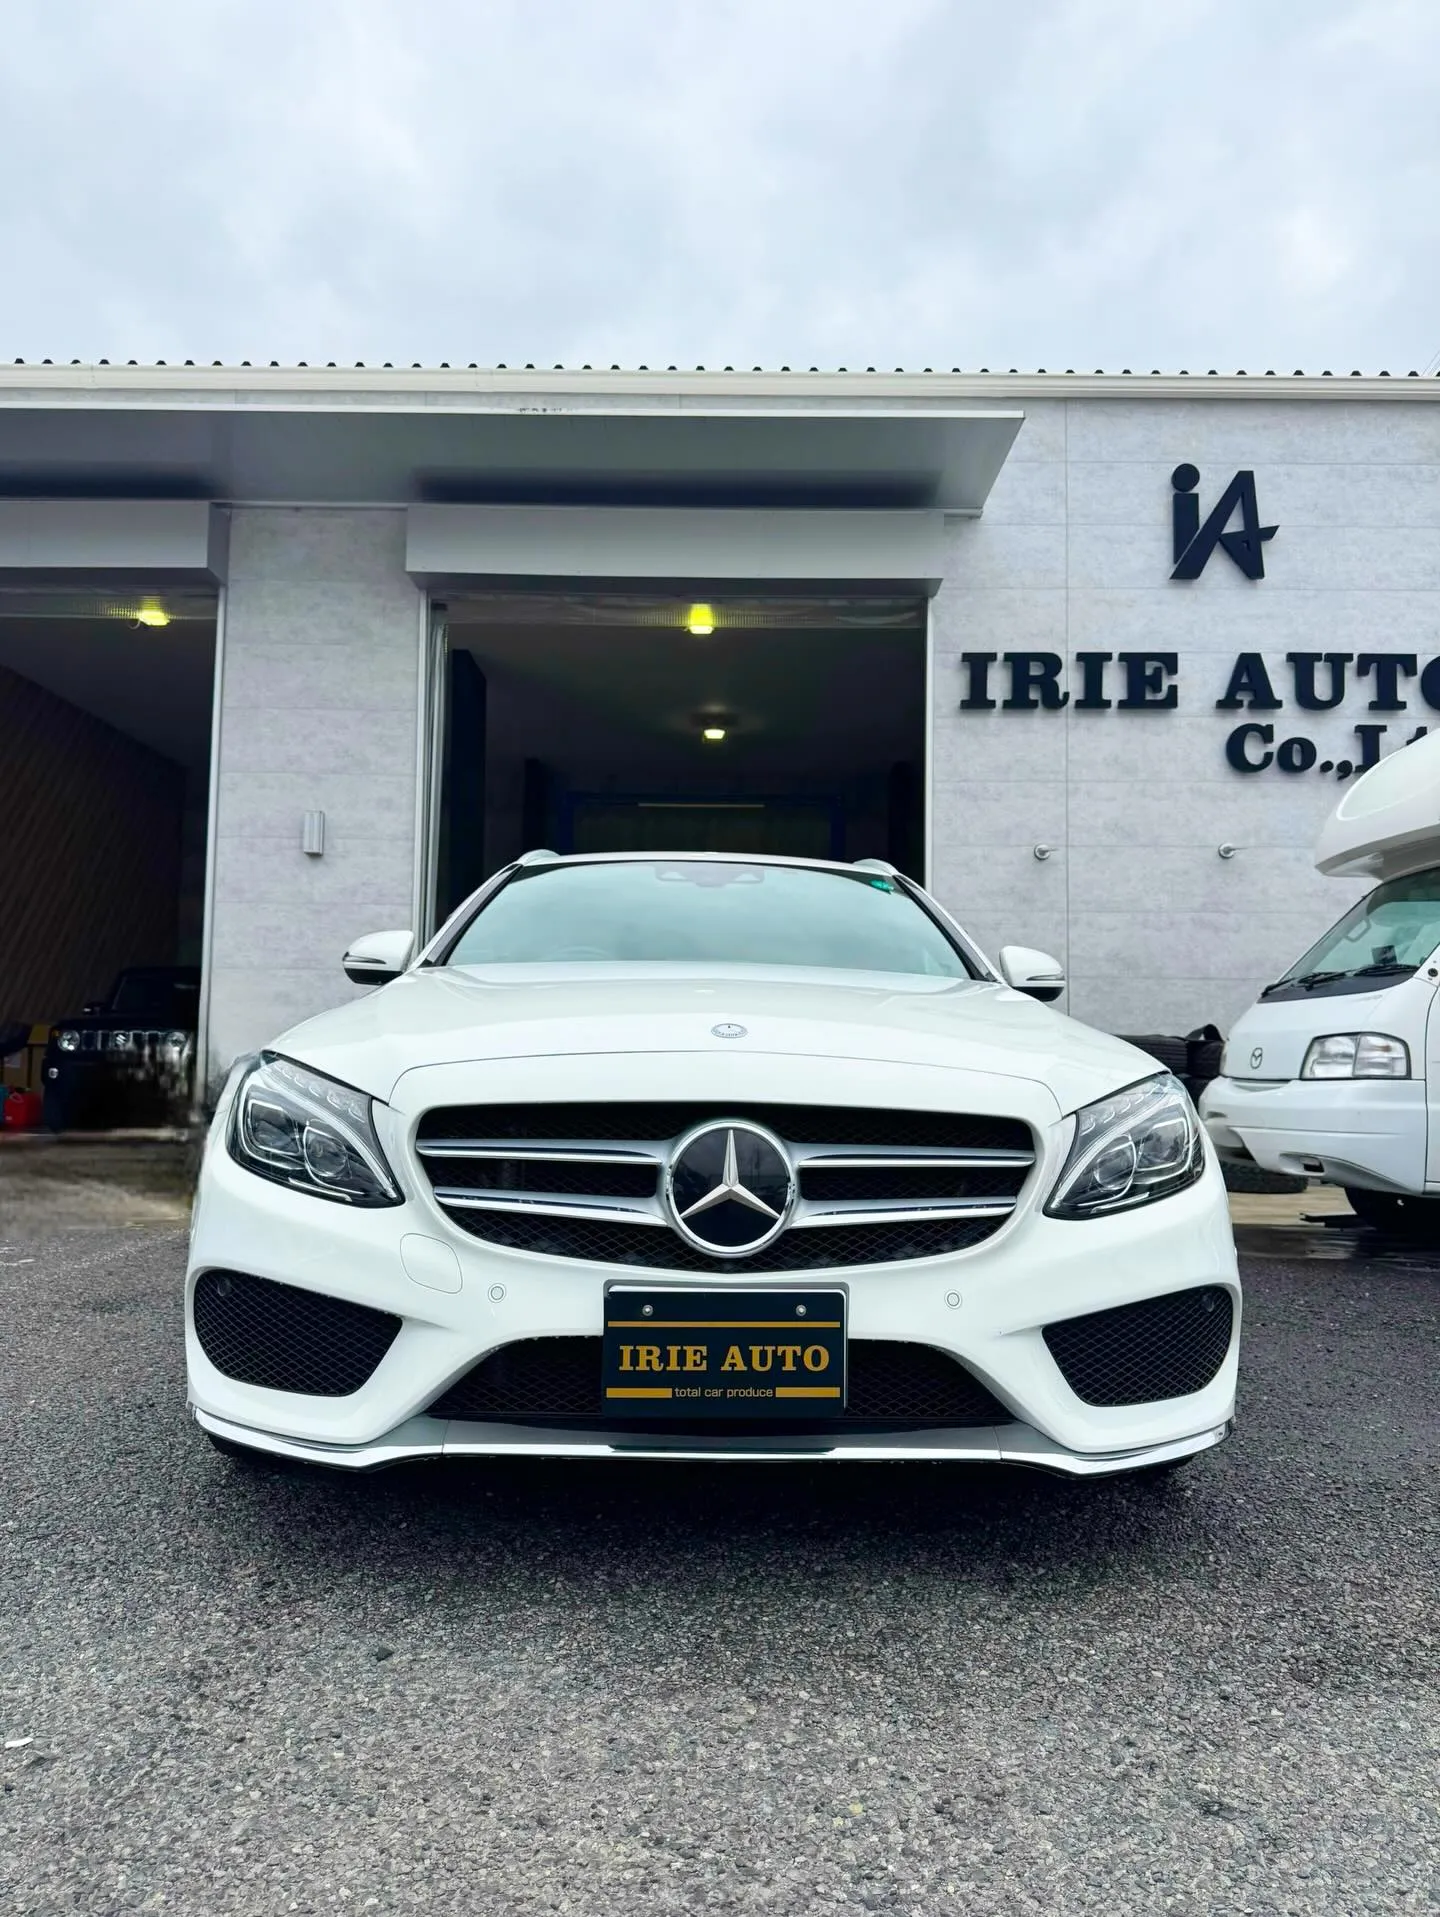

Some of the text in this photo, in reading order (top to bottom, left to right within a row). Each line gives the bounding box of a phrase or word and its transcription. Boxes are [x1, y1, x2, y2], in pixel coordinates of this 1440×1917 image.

[959, 651, 1179, 715] IRIE
[1226, 722, 1428, 782] Co.,L
[618, 1344, 830, 1372] IRIE AUTO
[674, 1387, 774, 1399] total car produce
